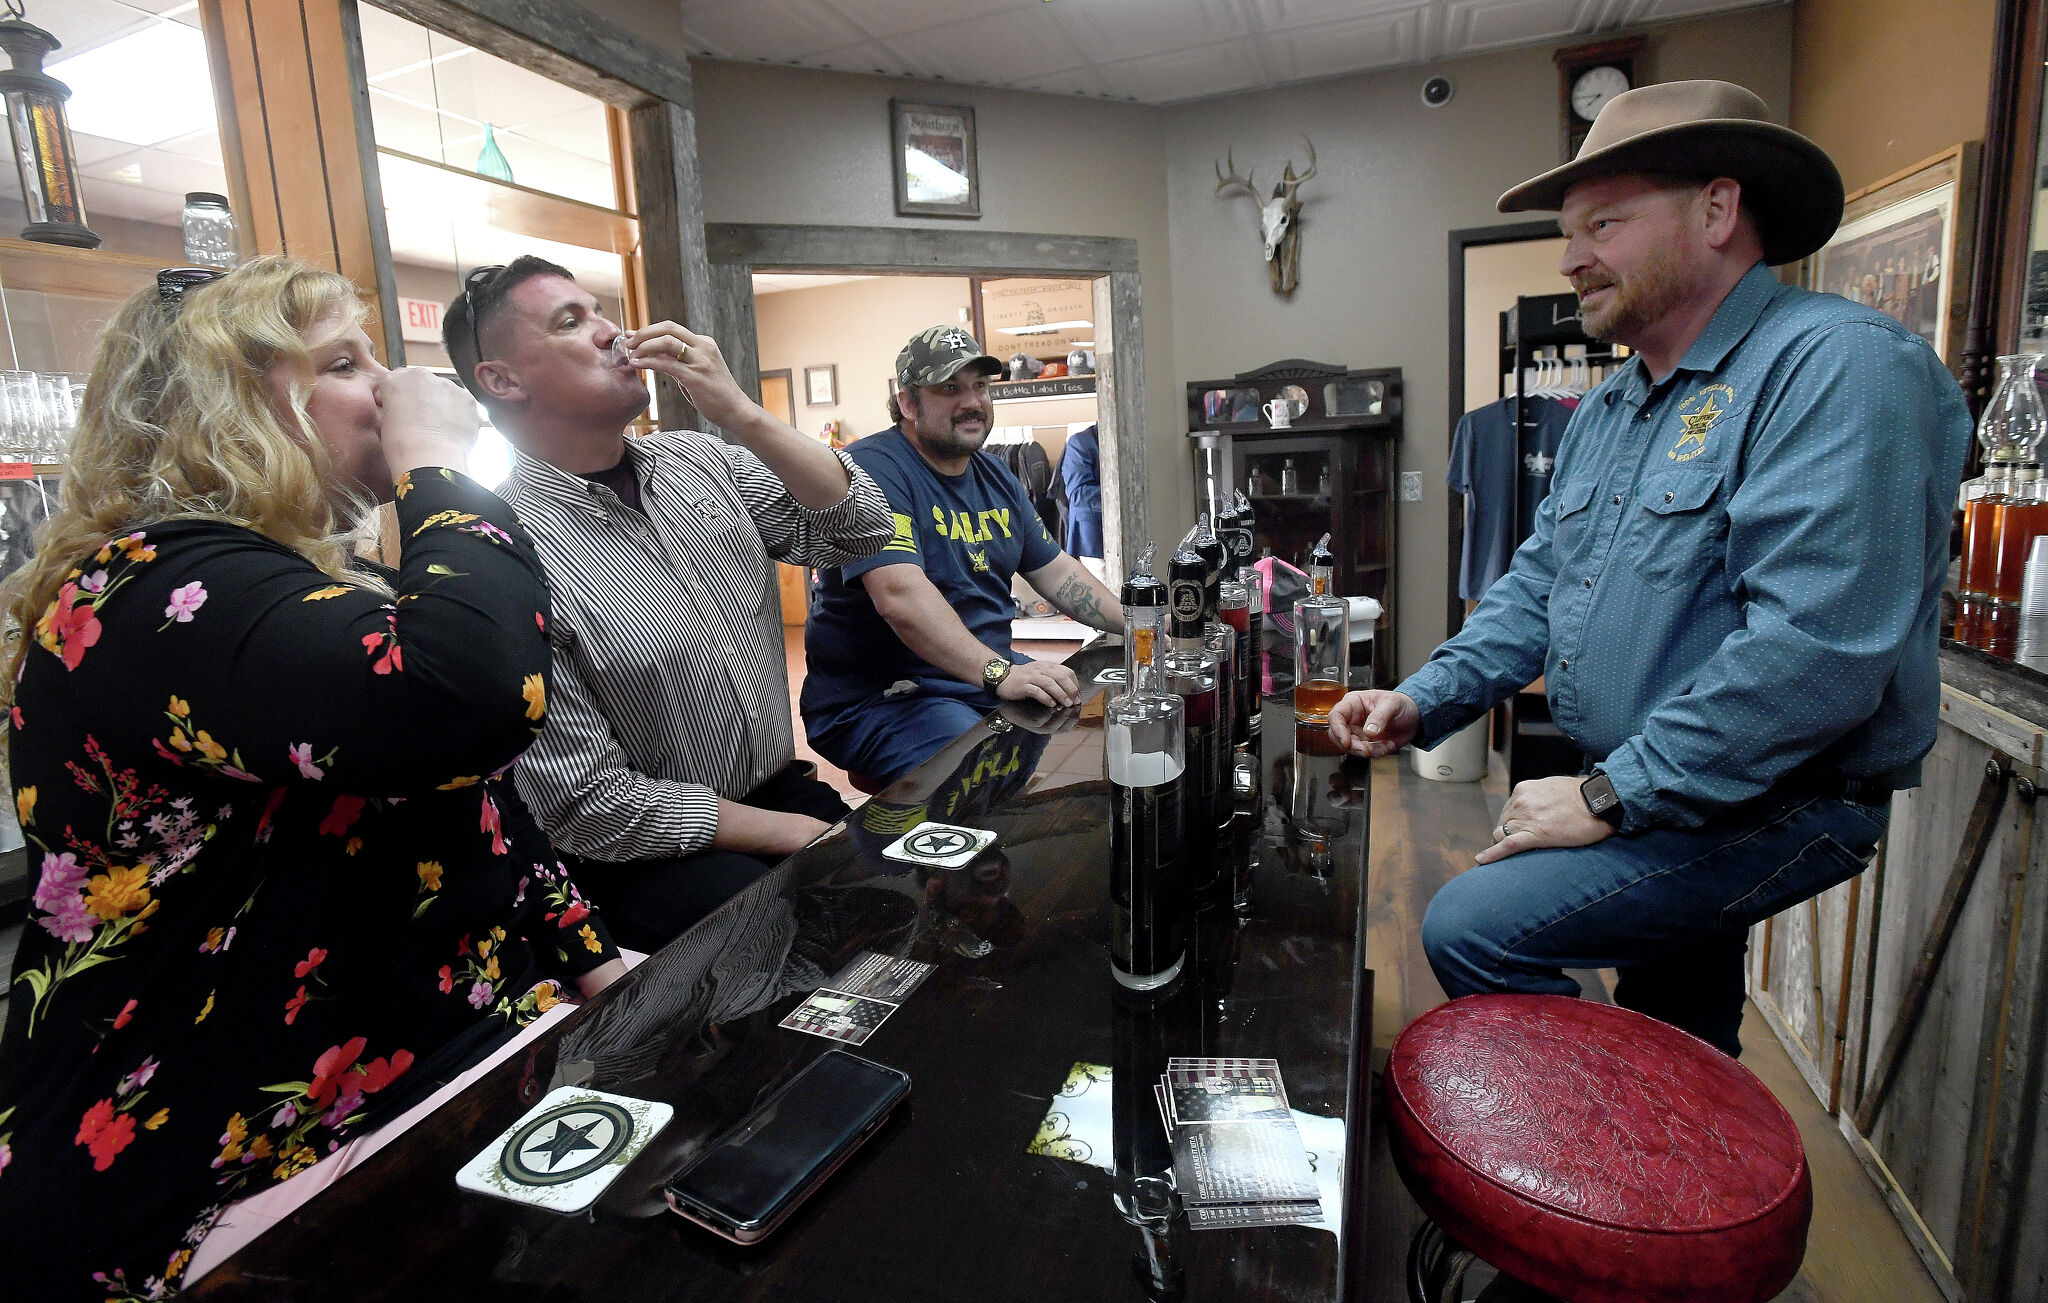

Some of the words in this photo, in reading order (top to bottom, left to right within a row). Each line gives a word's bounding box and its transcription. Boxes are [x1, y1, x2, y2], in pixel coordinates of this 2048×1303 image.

[407, 301, 439, 329] EXIT
[942, 330, 968, 351] H
[1024, 340, 1053, 349] TREAD
[1002, 385, 1031, 396] Bottle
[1062, 382, 1084, 392] Tees
[931, 504, 1013, 544] SALTY
